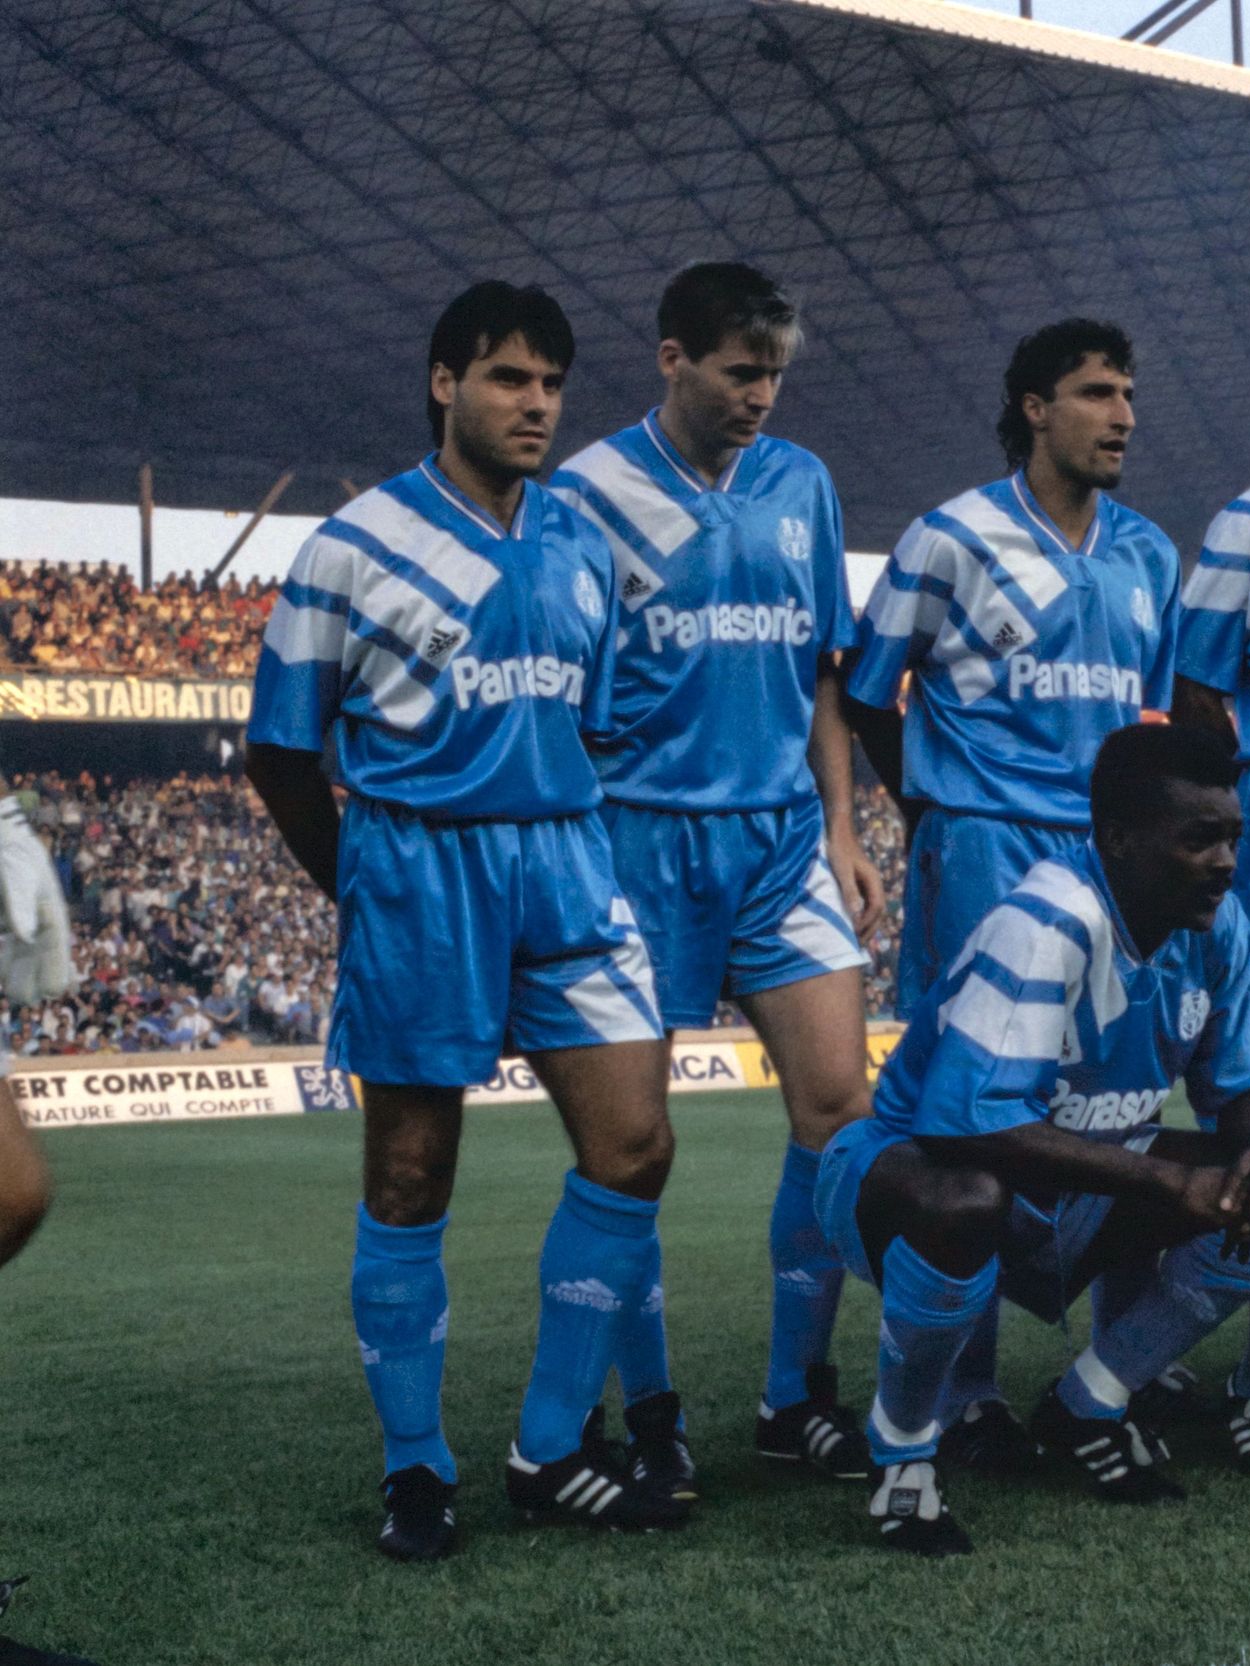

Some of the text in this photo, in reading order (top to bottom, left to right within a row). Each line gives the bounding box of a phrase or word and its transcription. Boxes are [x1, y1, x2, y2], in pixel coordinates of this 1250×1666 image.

[83, 1068, 269, 1096] COMPTABLE
[130, 1102, 172, 1117] QUI
[186, 1098, 275, 1115] COMPTE
